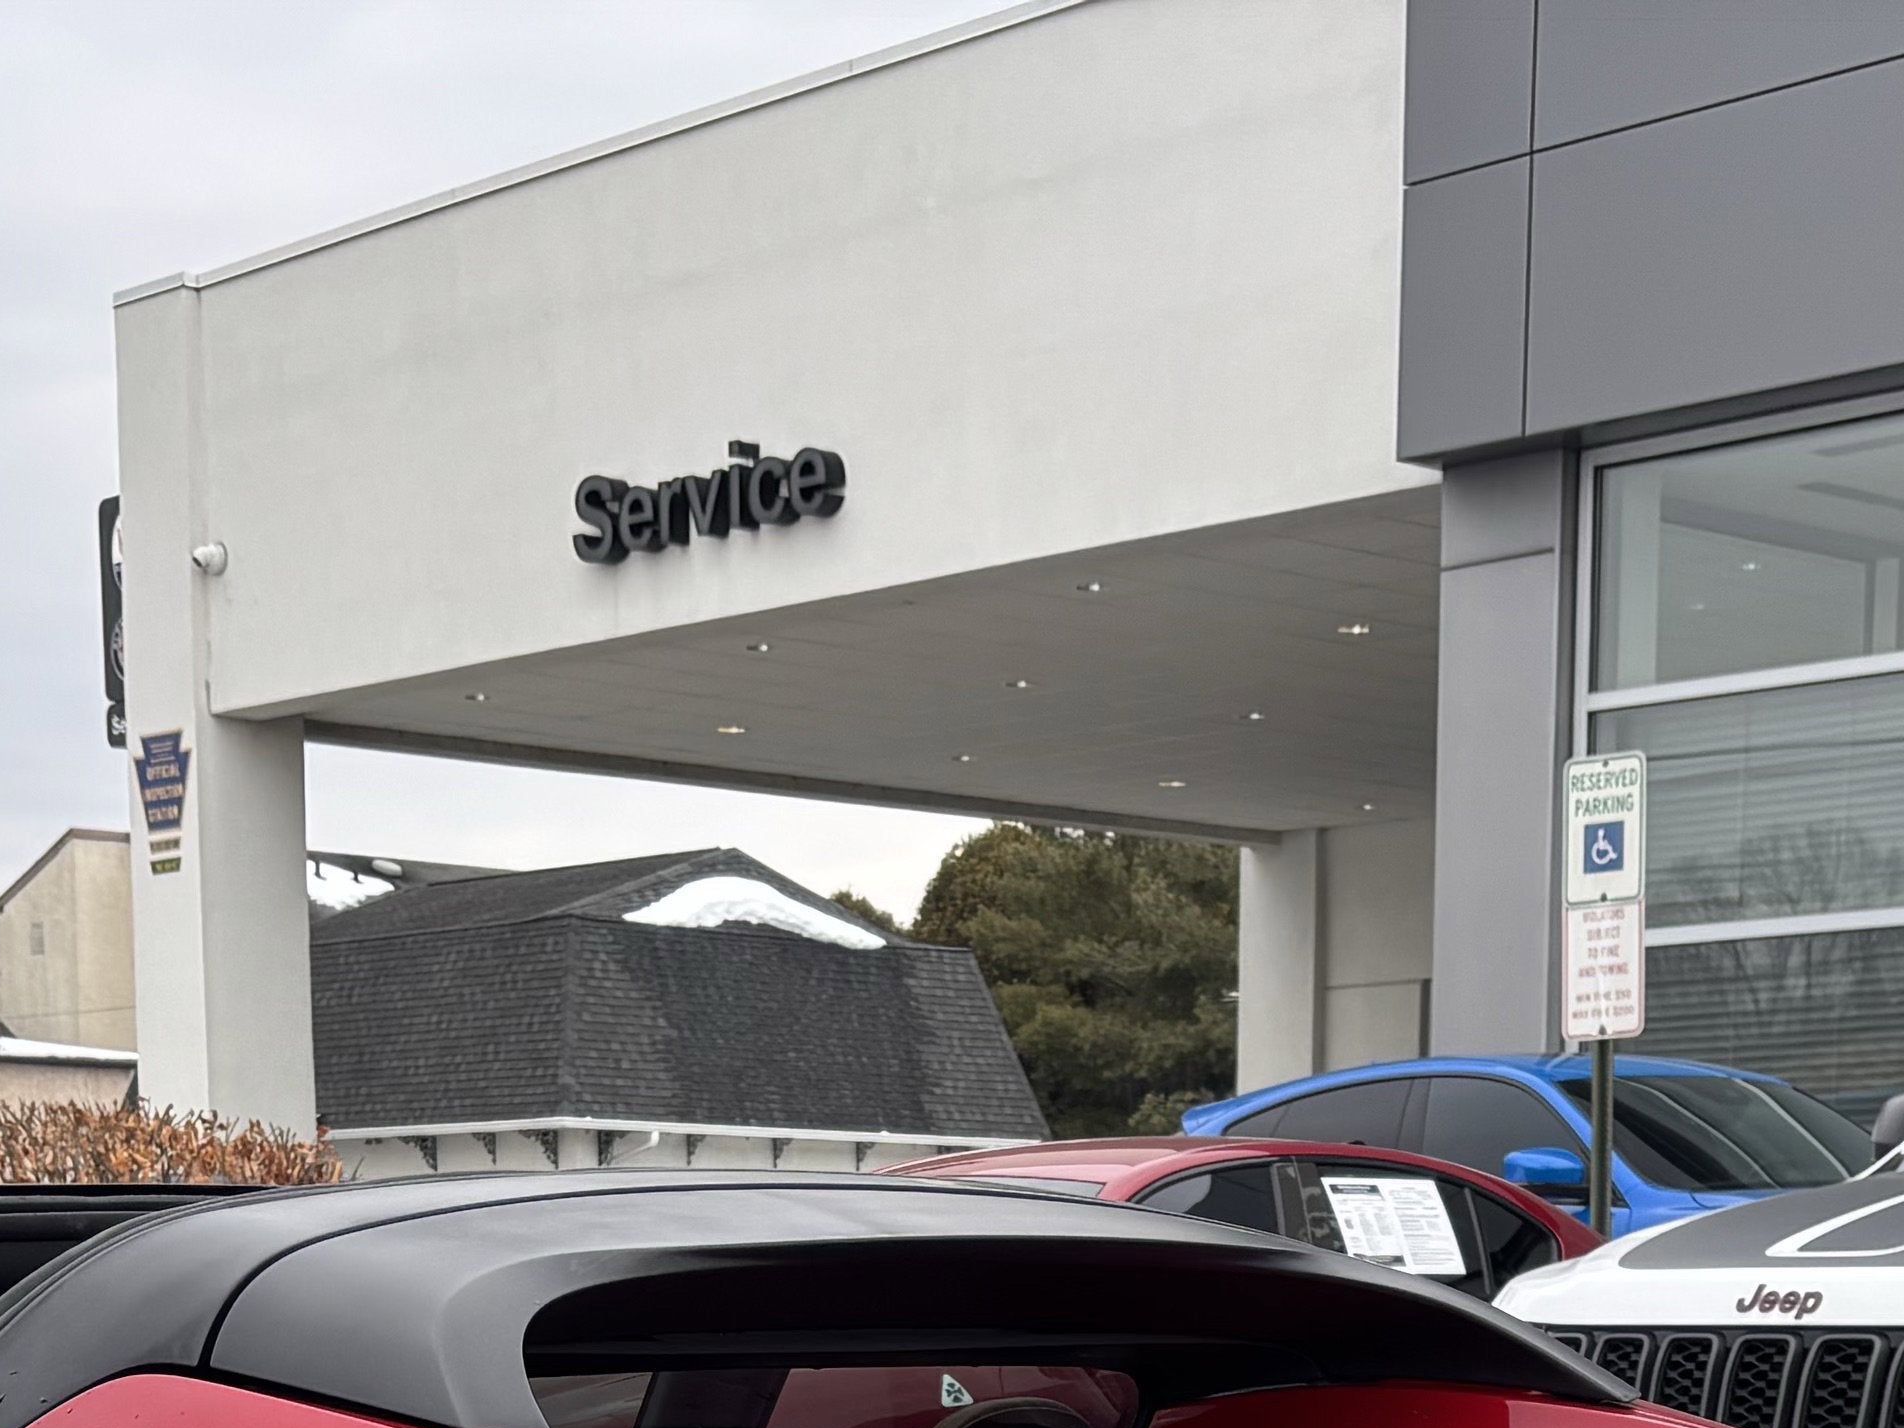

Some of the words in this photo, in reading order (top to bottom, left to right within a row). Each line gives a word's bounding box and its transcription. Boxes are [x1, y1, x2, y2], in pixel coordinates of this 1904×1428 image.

[573, 440, 846, 564] Service
[1570, 767, 1638, 793] RESERVED
[1574, 794, 1634, 818] PARKING
[1736, 1284, 1823, 1320] Jeep
